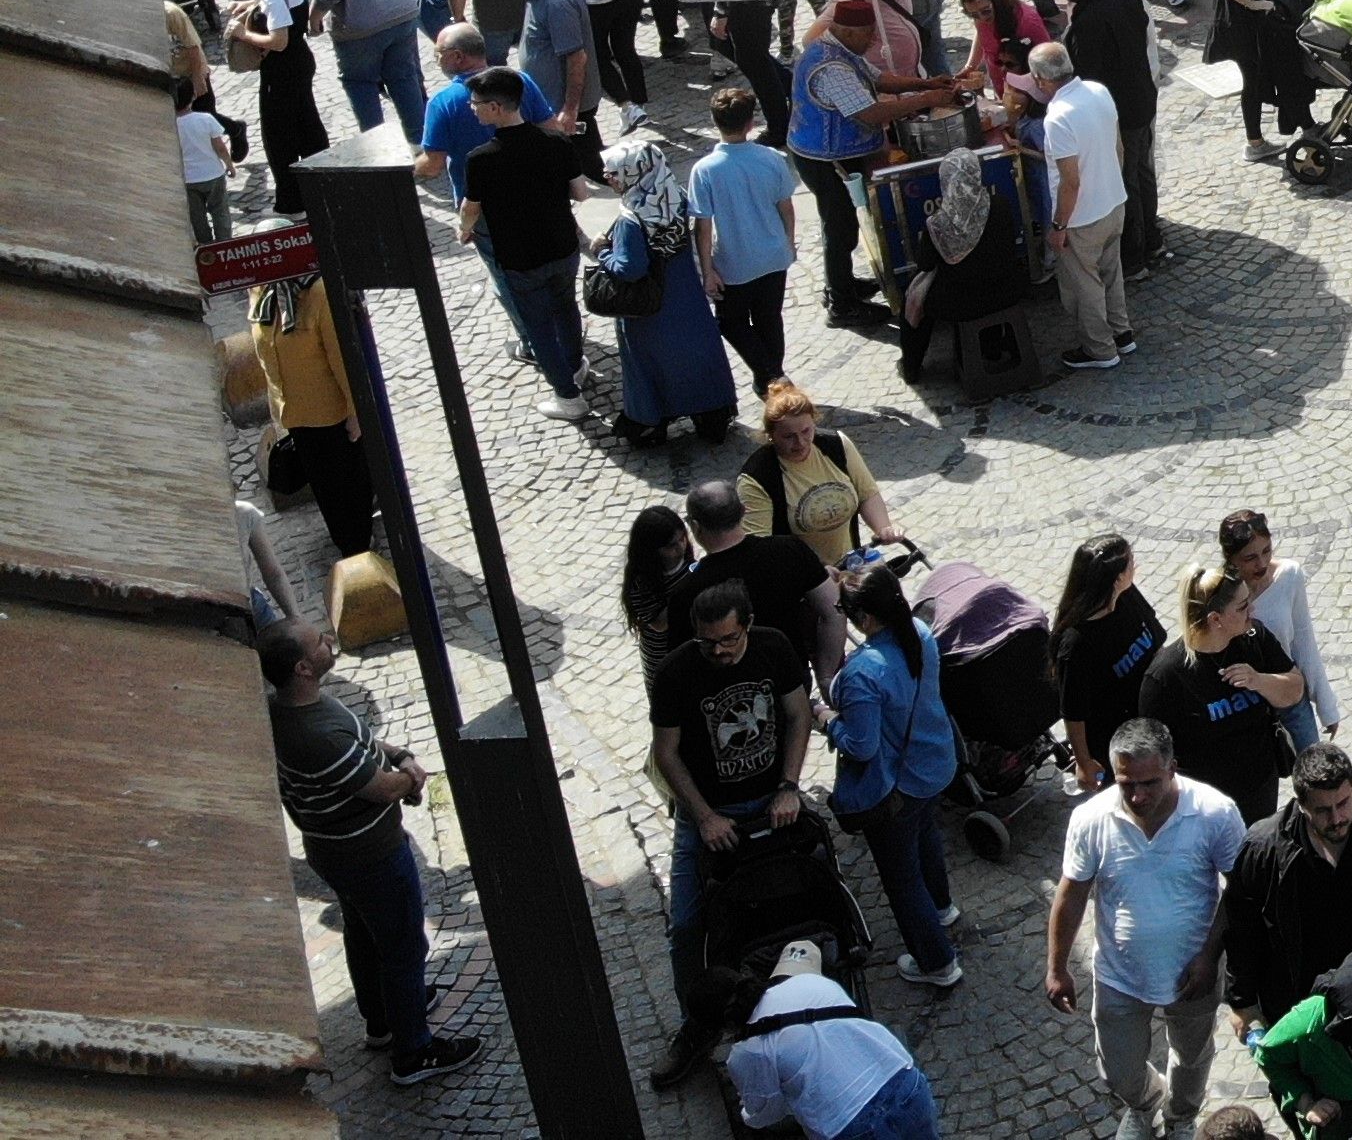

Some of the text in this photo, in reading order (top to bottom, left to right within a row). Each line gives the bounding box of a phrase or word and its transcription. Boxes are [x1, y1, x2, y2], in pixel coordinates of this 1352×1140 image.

[217, 240, 271, 263] TAHMİS
[1112, 621, 1155, 679] mavi
[1206, 690, 1261, 722] mav
